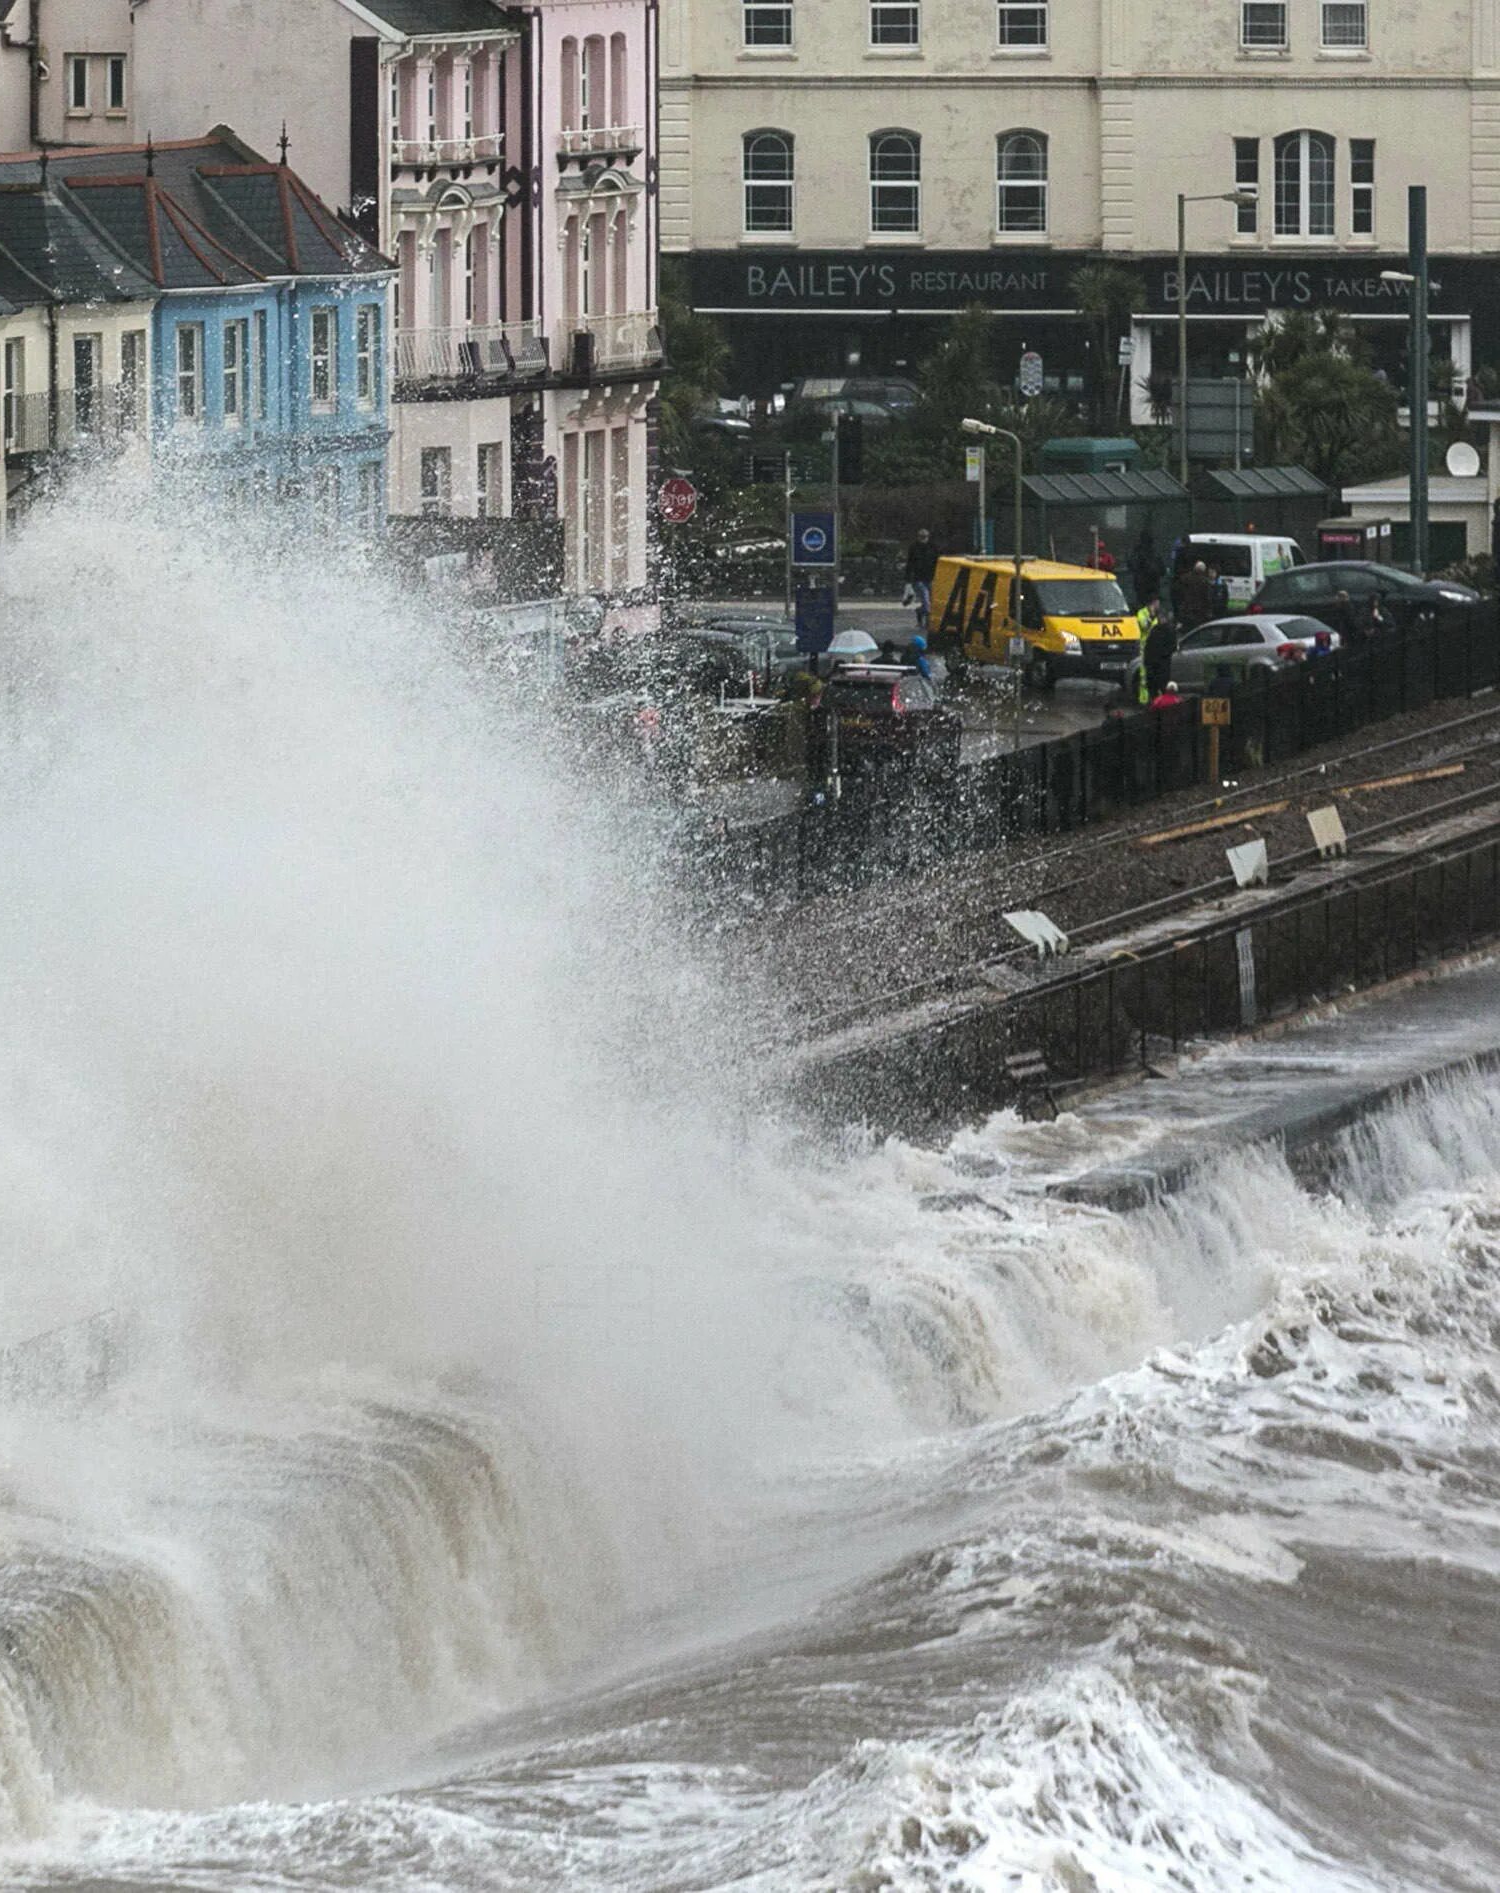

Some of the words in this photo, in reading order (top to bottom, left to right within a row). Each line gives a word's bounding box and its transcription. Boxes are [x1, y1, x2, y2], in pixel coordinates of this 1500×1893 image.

[748, 265, 896, 297] BAILEY'S
[910, 271, 1049, 292] RESTAURANT
[1162, 270, 1312, 303] BAILEY'S
[660, 493, 695, 508] STOP
[938, 567, 998, 648] AA
[1101, 624, 1123, 638] AA
